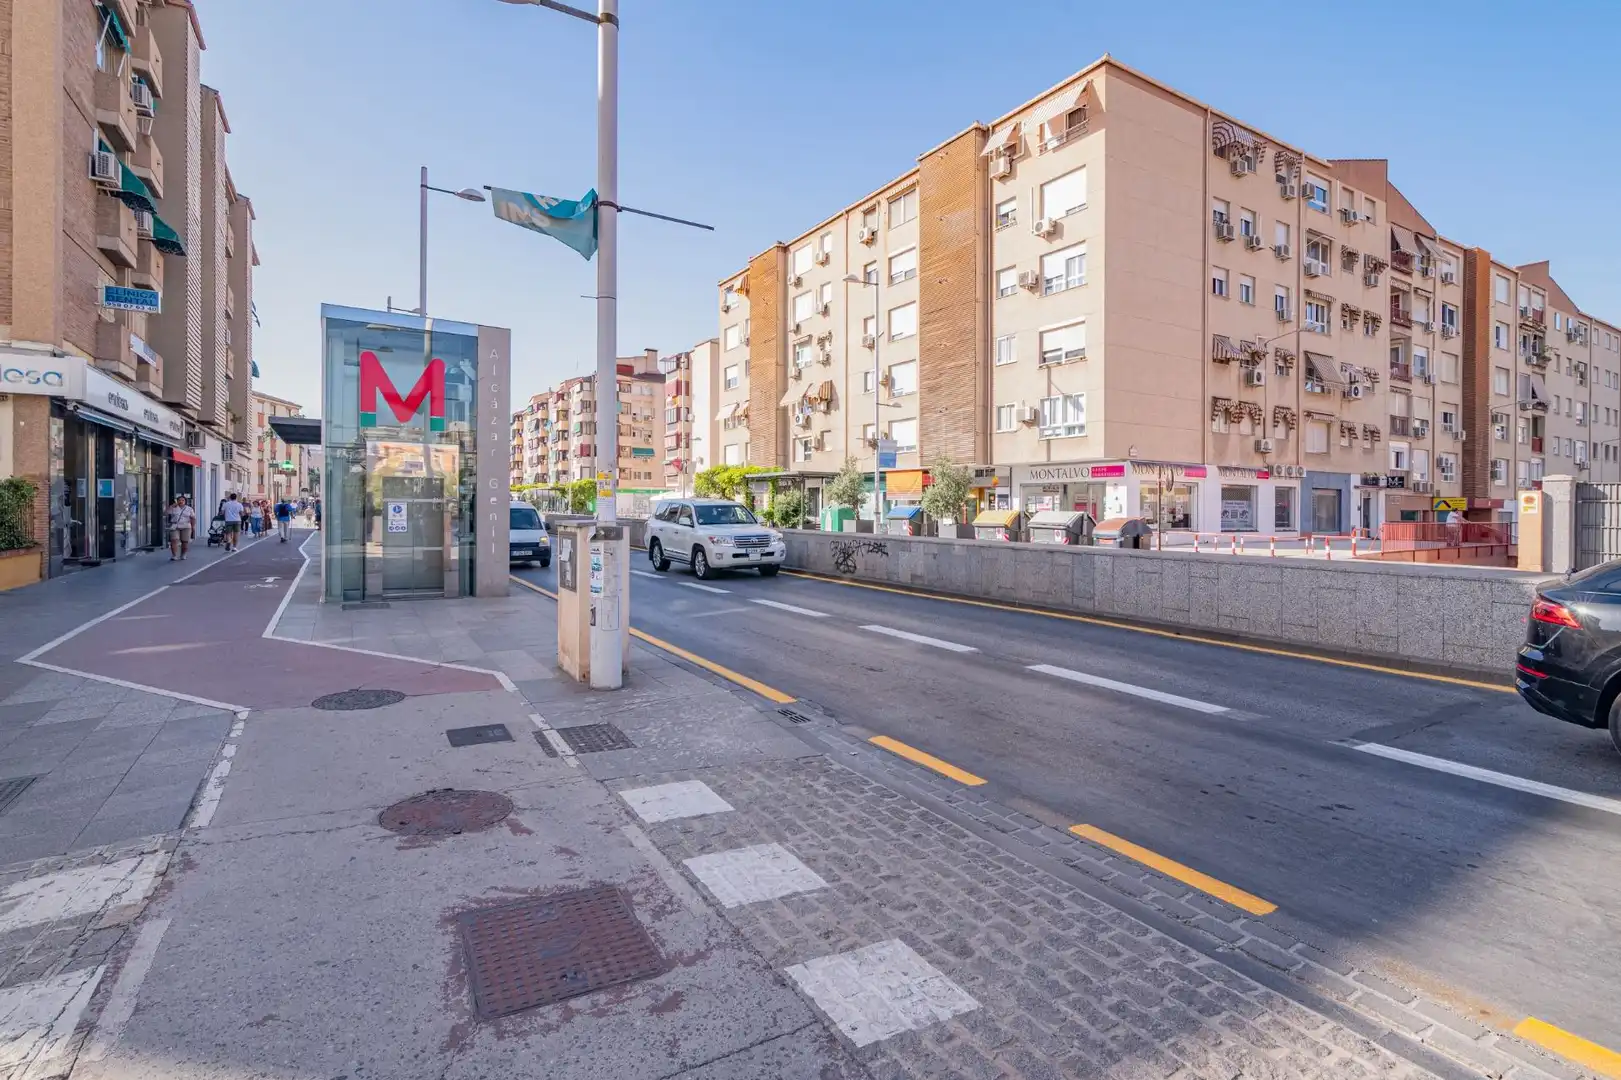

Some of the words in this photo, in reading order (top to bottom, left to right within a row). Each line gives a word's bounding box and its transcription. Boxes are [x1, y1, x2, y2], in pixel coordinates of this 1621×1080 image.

[106, 294, 157, 306] DENTAL
[0, 363, 64, 387] esa
[360, 351, 446, 431] M
[489, 348, 499, 457] Alcázar
[1030, 467, 1090, 481] MONTALVO
[488, 478, 499, 555] Genil
